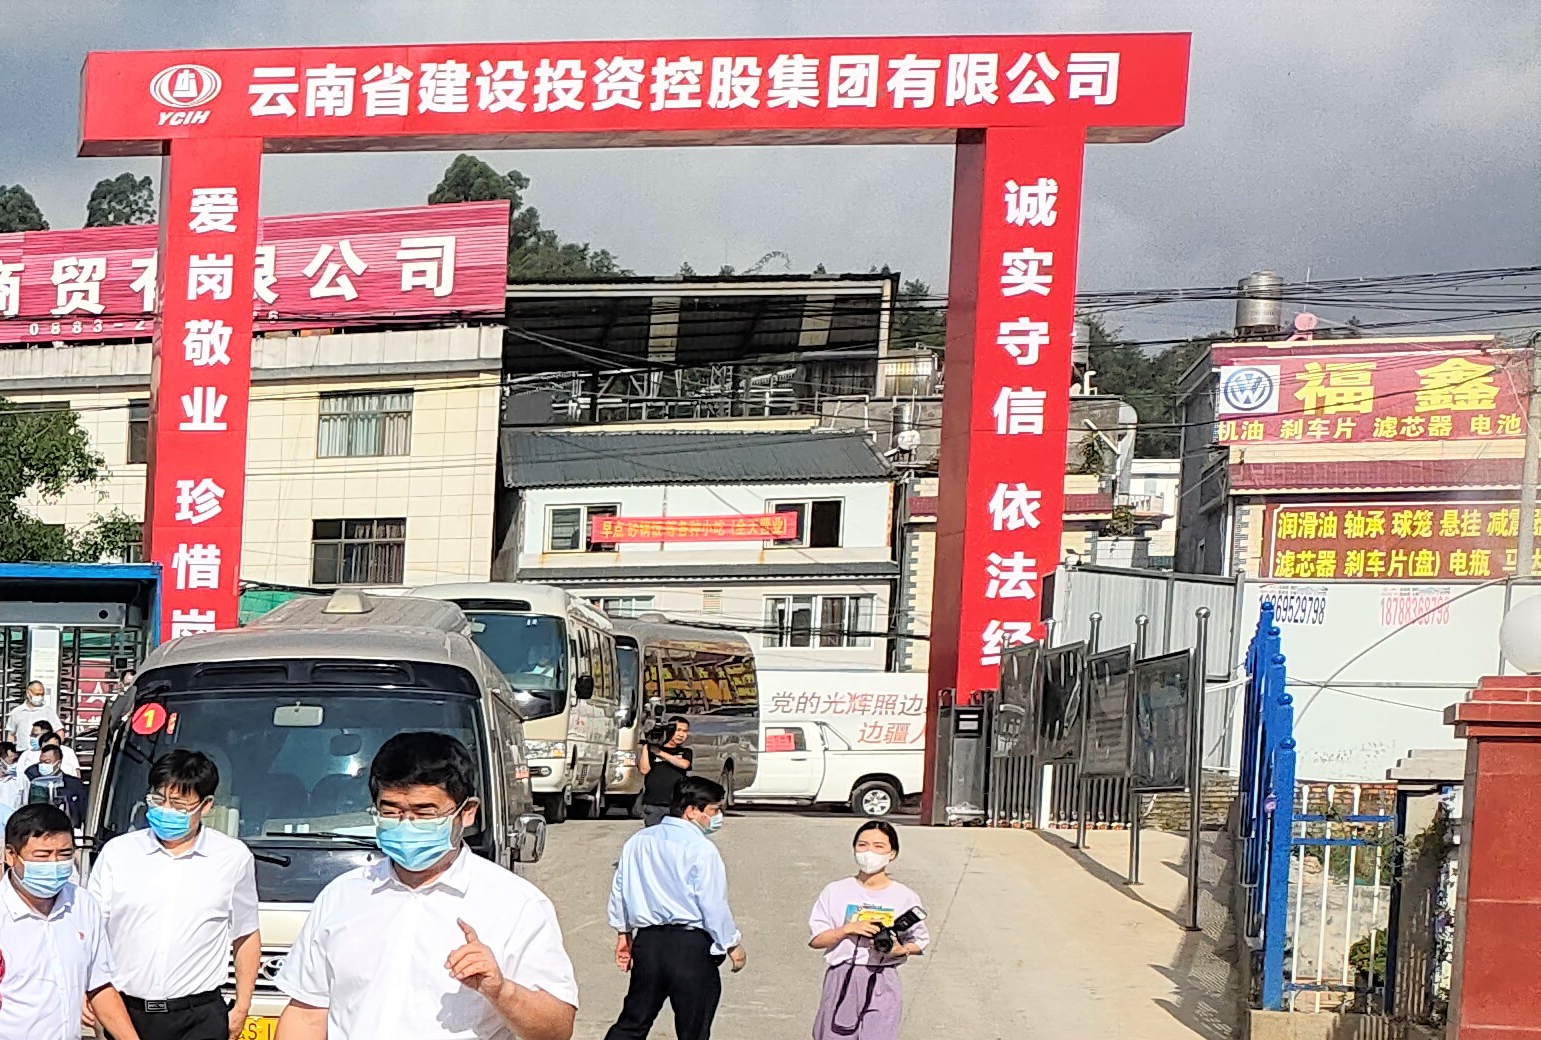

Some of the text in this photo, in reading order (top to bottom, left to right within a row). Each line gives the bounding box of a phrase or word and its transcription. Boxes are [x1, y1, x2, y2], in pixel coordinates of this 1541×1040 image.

[246, 51, 1120, 118] 云南省建设投资控股集团有限公司
[157, 110, 211, 126] YCIH
[179, 186, 239, 432] 爱岗敬业
[992, 178, 1059, 436] 诚实守信
[1218, 413, 1522, 441] 机油 刹车片 滤芯器 电池
[1277, 510, 1337, 540] 润滑油
[1344, 509, 1385, 539] 轴承
[1391, 509, 1434, 539] 球笼
[1439, 508, 1481, 537] 悬挂
[1274, 549, 1337, 578] 滤芯器
[1344, 548, 1441, 578] 刹车片(盘)
[1449, 548, 1491, 577] 电瓶
[143, 709, 156, 728] 1
[768, 691, 928, 717] 党的光辉照边
